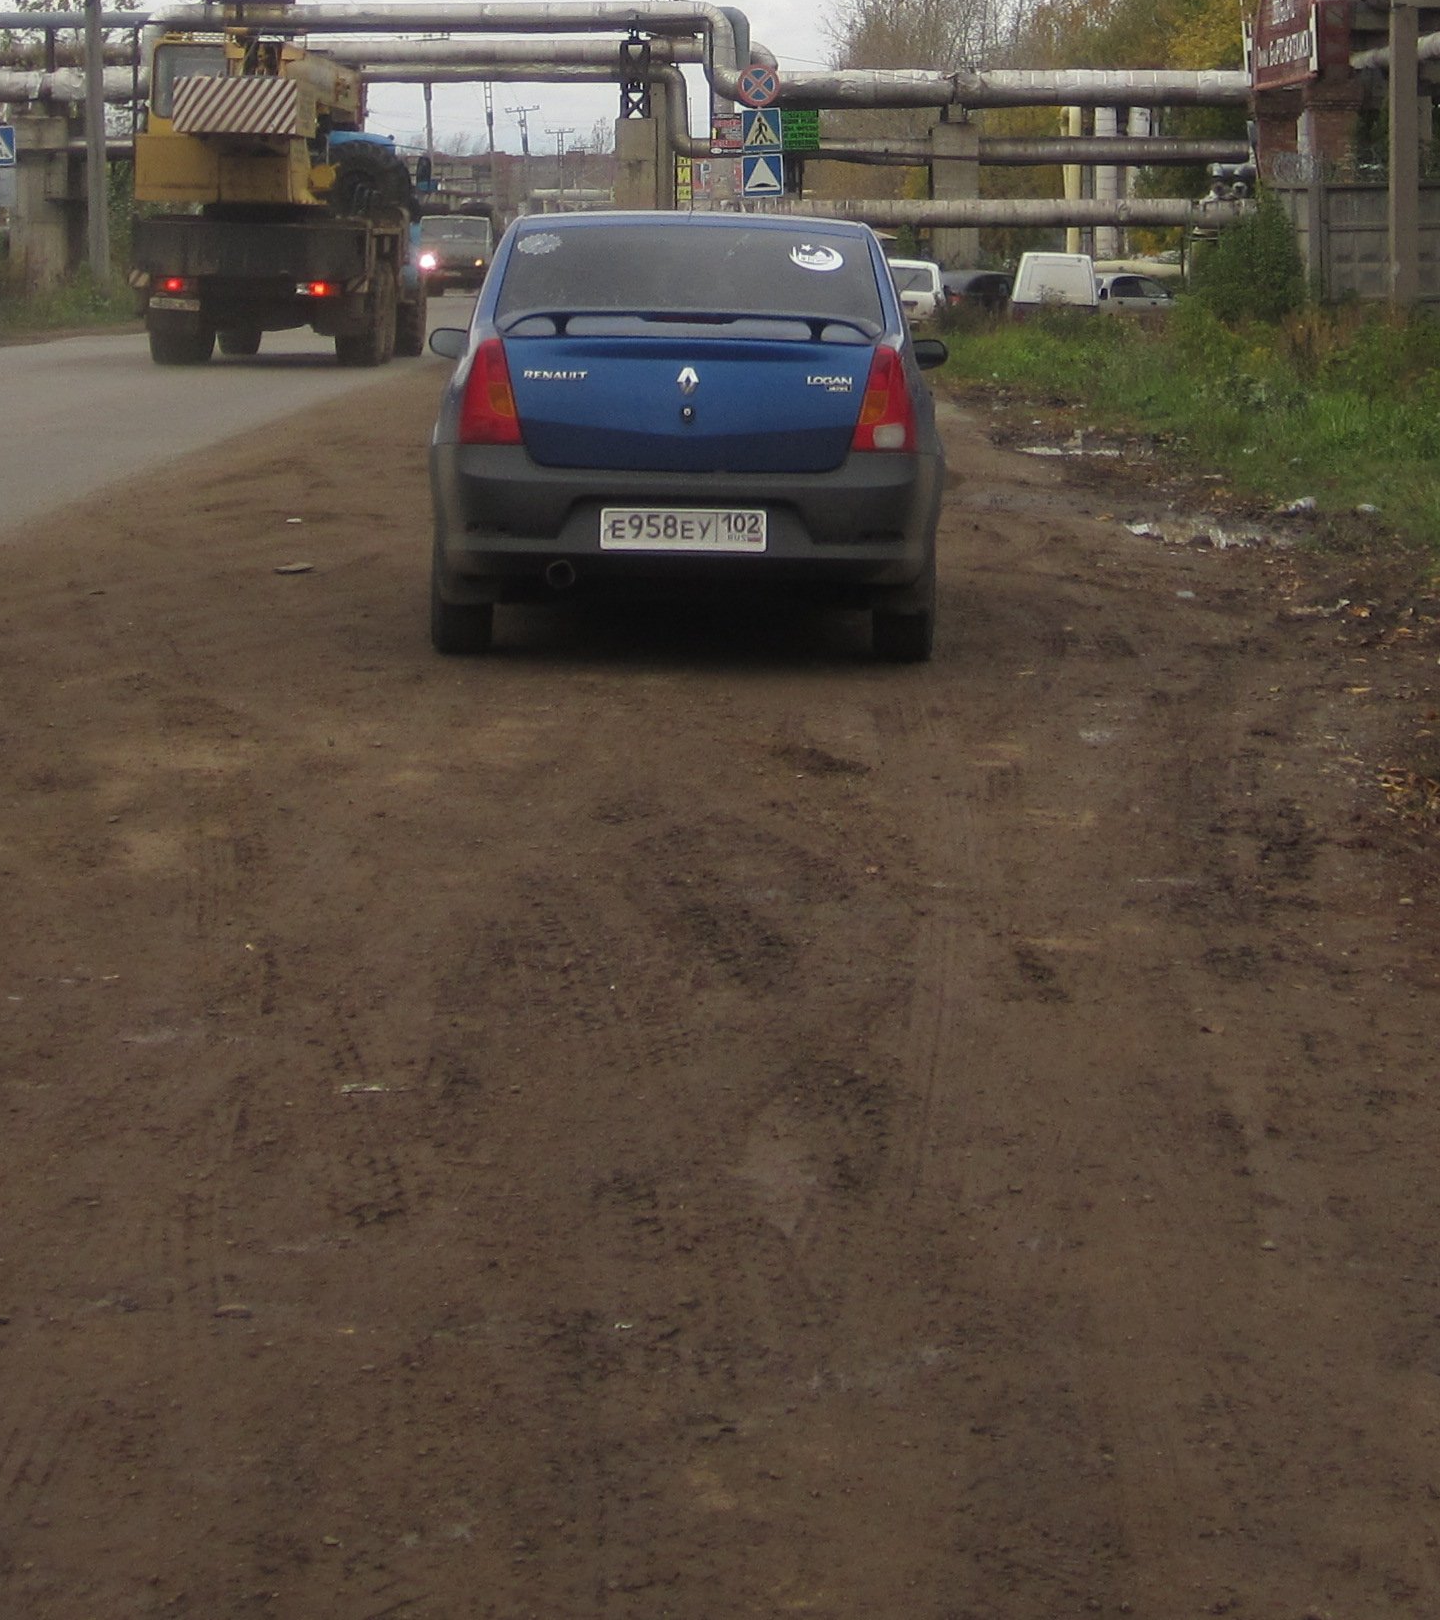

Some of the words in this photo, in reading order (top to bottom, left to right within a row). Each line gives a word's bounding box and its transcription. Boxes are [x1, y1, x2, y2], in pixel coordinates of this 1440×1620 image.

[523, 370, 588, 379] RENAULT
[807, 375, 852, 385] LOGAN
[721, 512, 761, 534] 102
